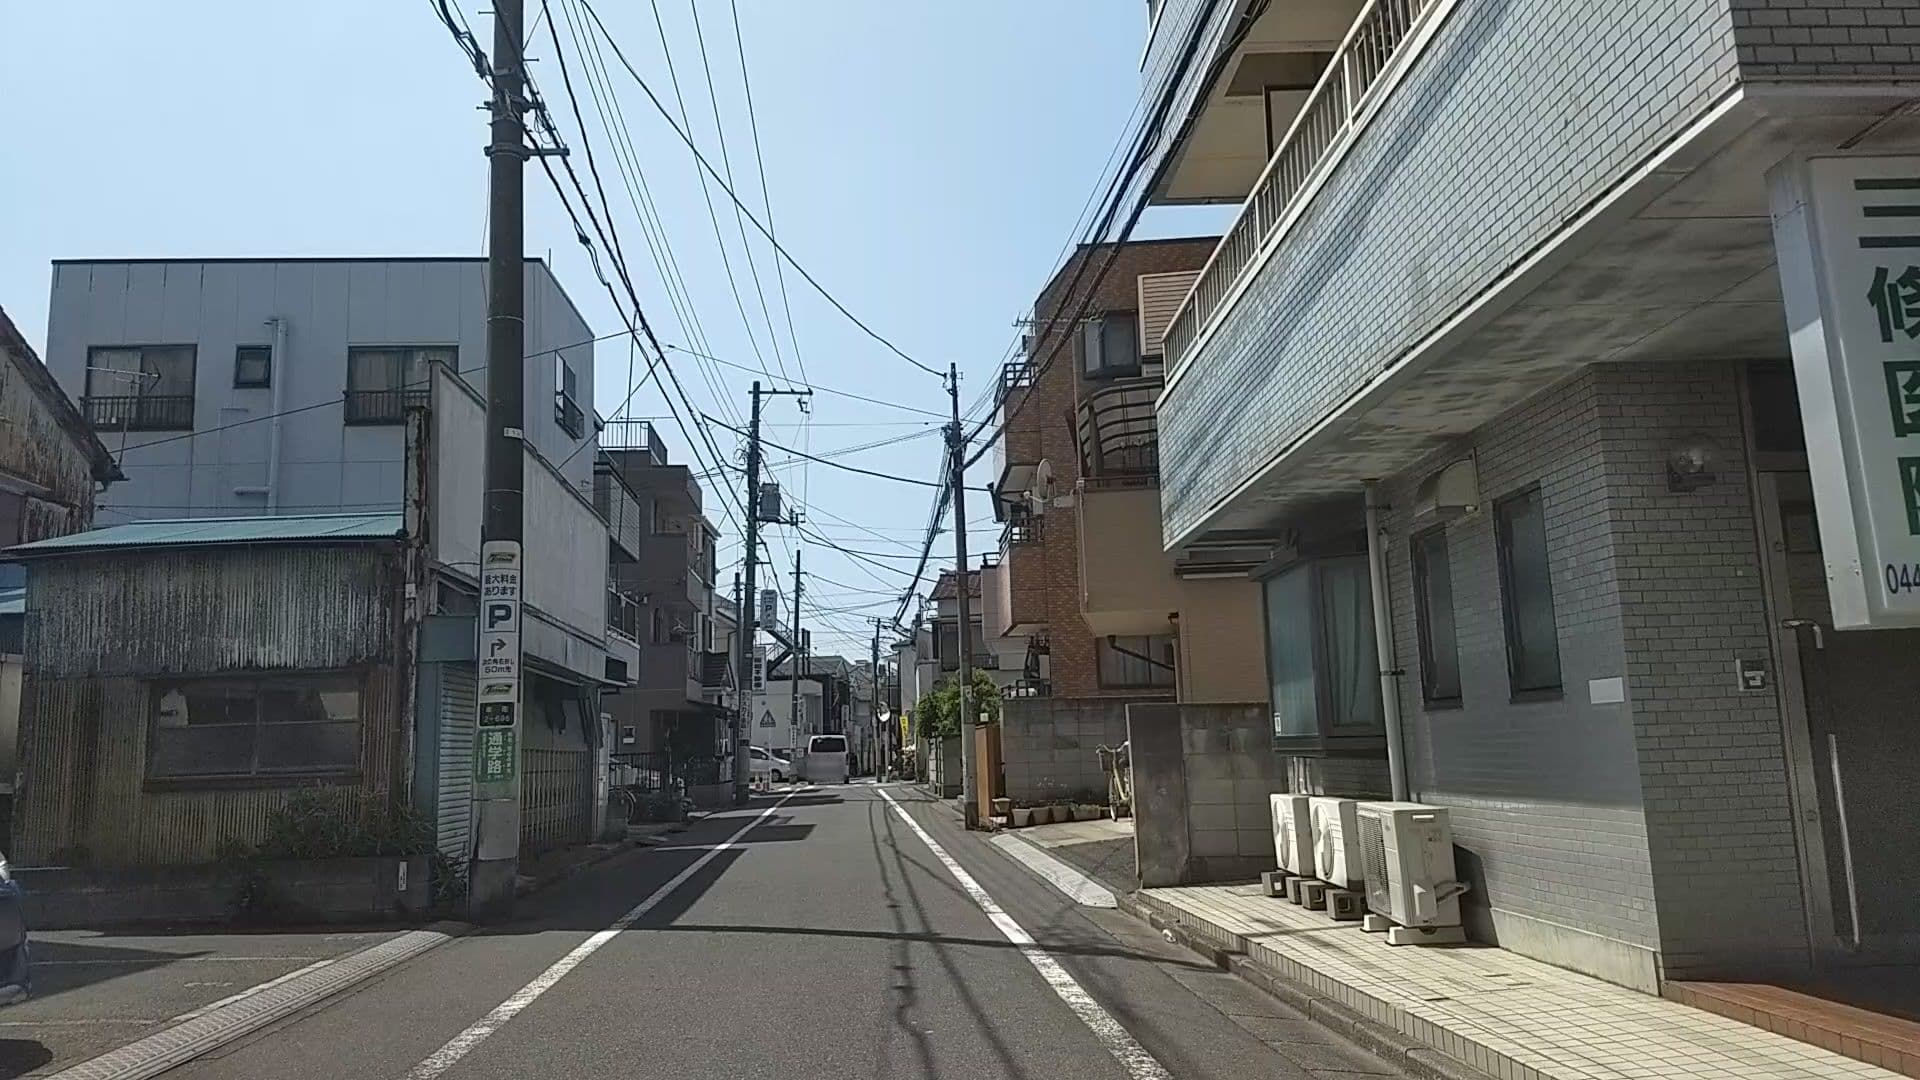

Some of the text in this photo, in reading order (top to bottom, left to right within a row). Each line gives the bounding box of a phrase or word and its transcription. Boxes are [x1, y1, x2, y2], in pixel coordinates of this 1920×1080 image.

[1854, 178, 1920, 536] 三修
[485, 574, 517, 585] 最大料金
[1886, 563, 1920, 594] 044
[484, 586, 517, 597] あります
[488, 604, 512, 629] P
[765, 604, 773, 612] P
[487, 732, 503, 774] 通学路
